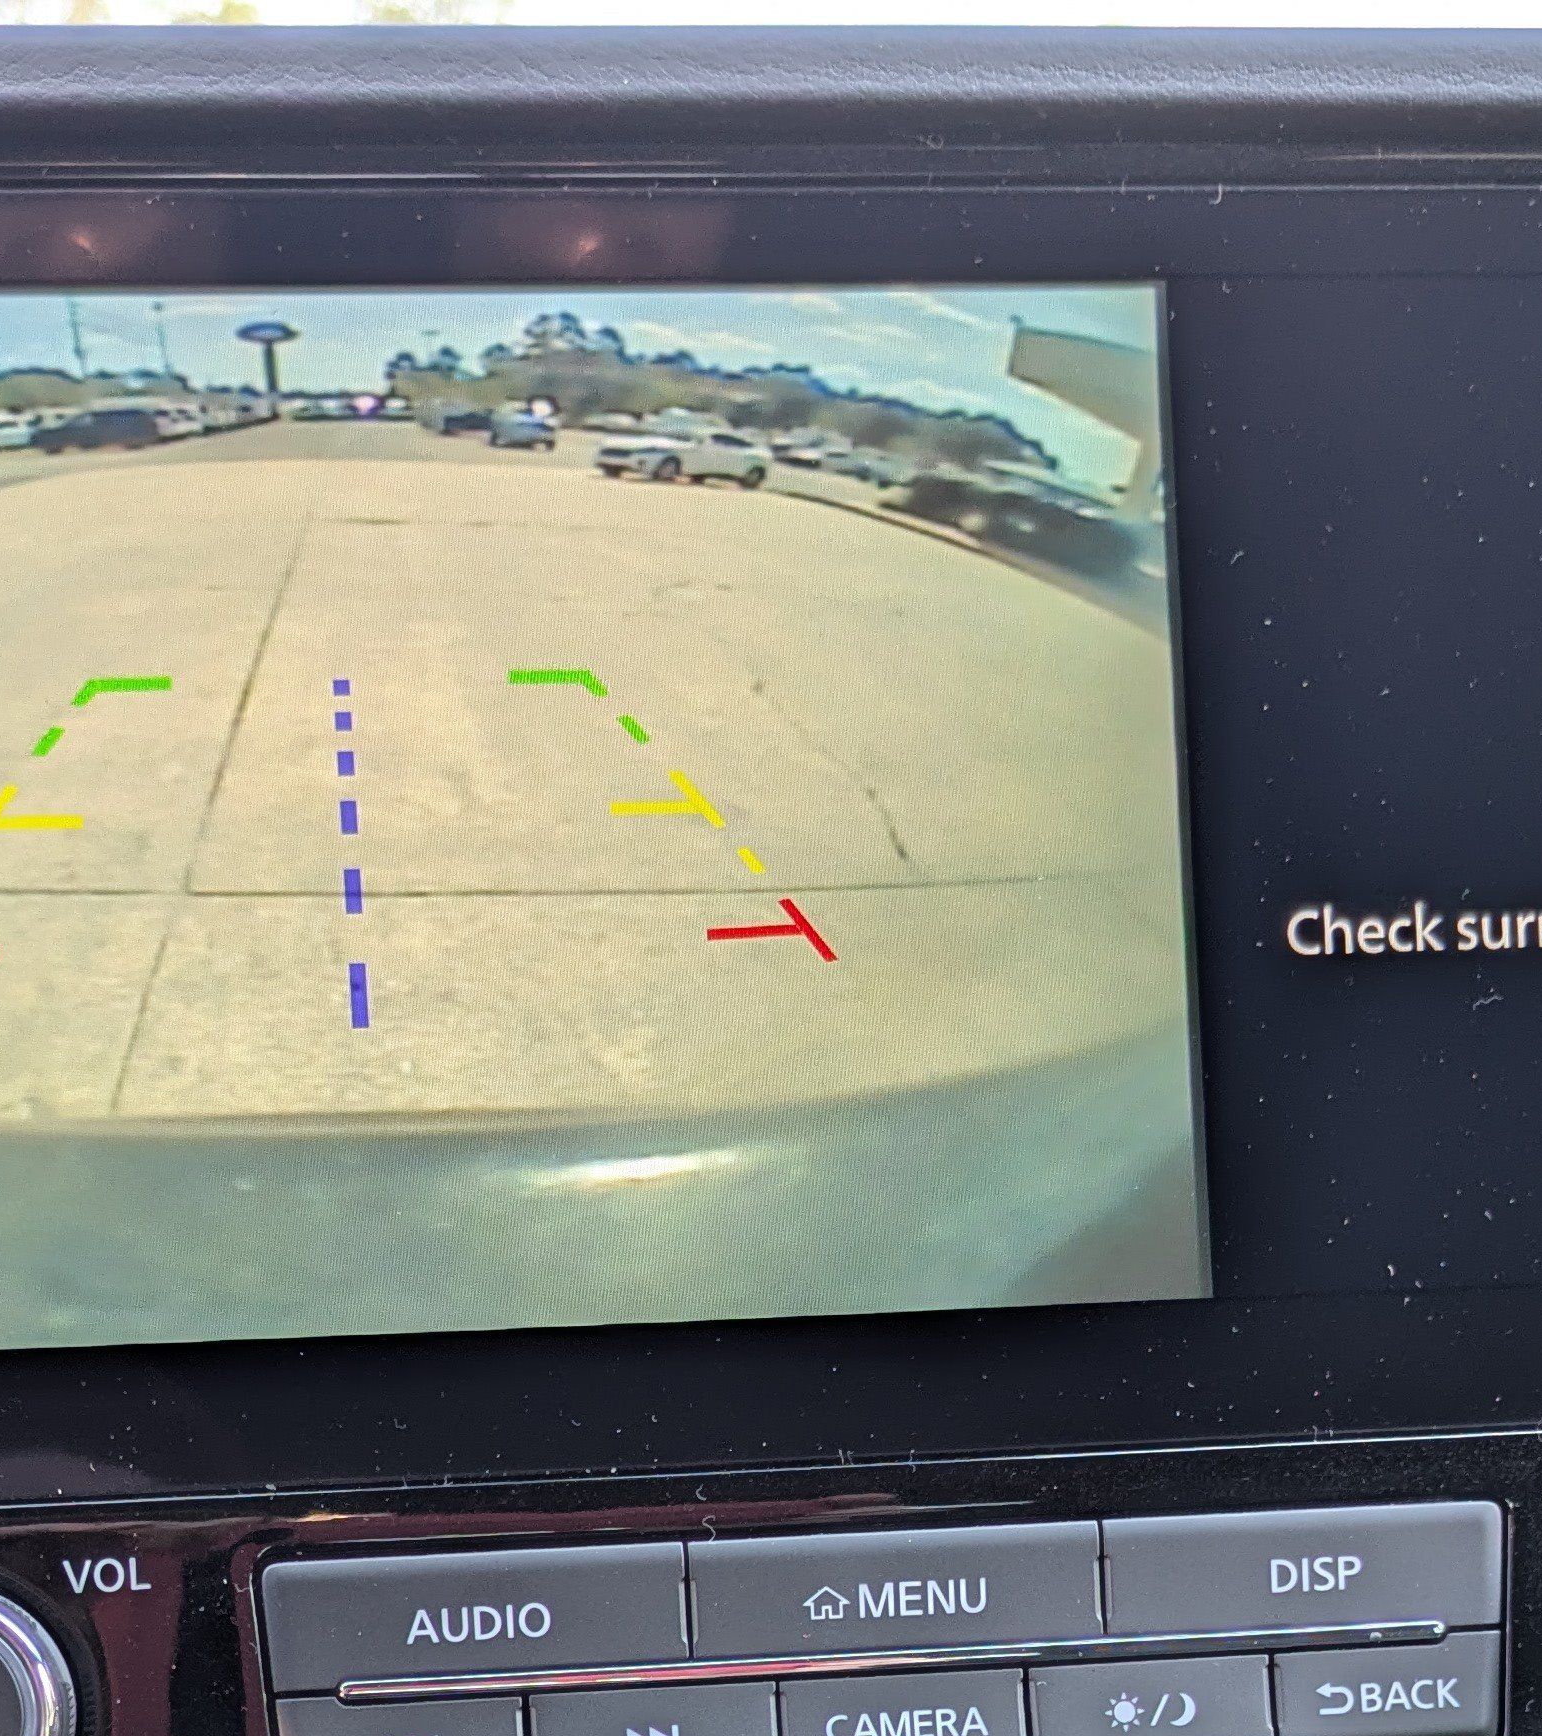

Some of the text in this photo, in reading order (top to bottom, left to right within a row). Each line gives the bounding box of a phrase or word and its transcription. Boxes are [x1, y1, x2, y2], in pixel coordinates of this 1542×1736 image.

[1287, 901, 1444, 955] Check
[61, 1556, 152, 1594] VOL
[1270, 1556, 1361, 1594] DISP
[859, 1577, 987, 1619] MENU
[405, 1602, 552, 1646] AUDIO
[1360, 1678, 1459, 1715] BACK
